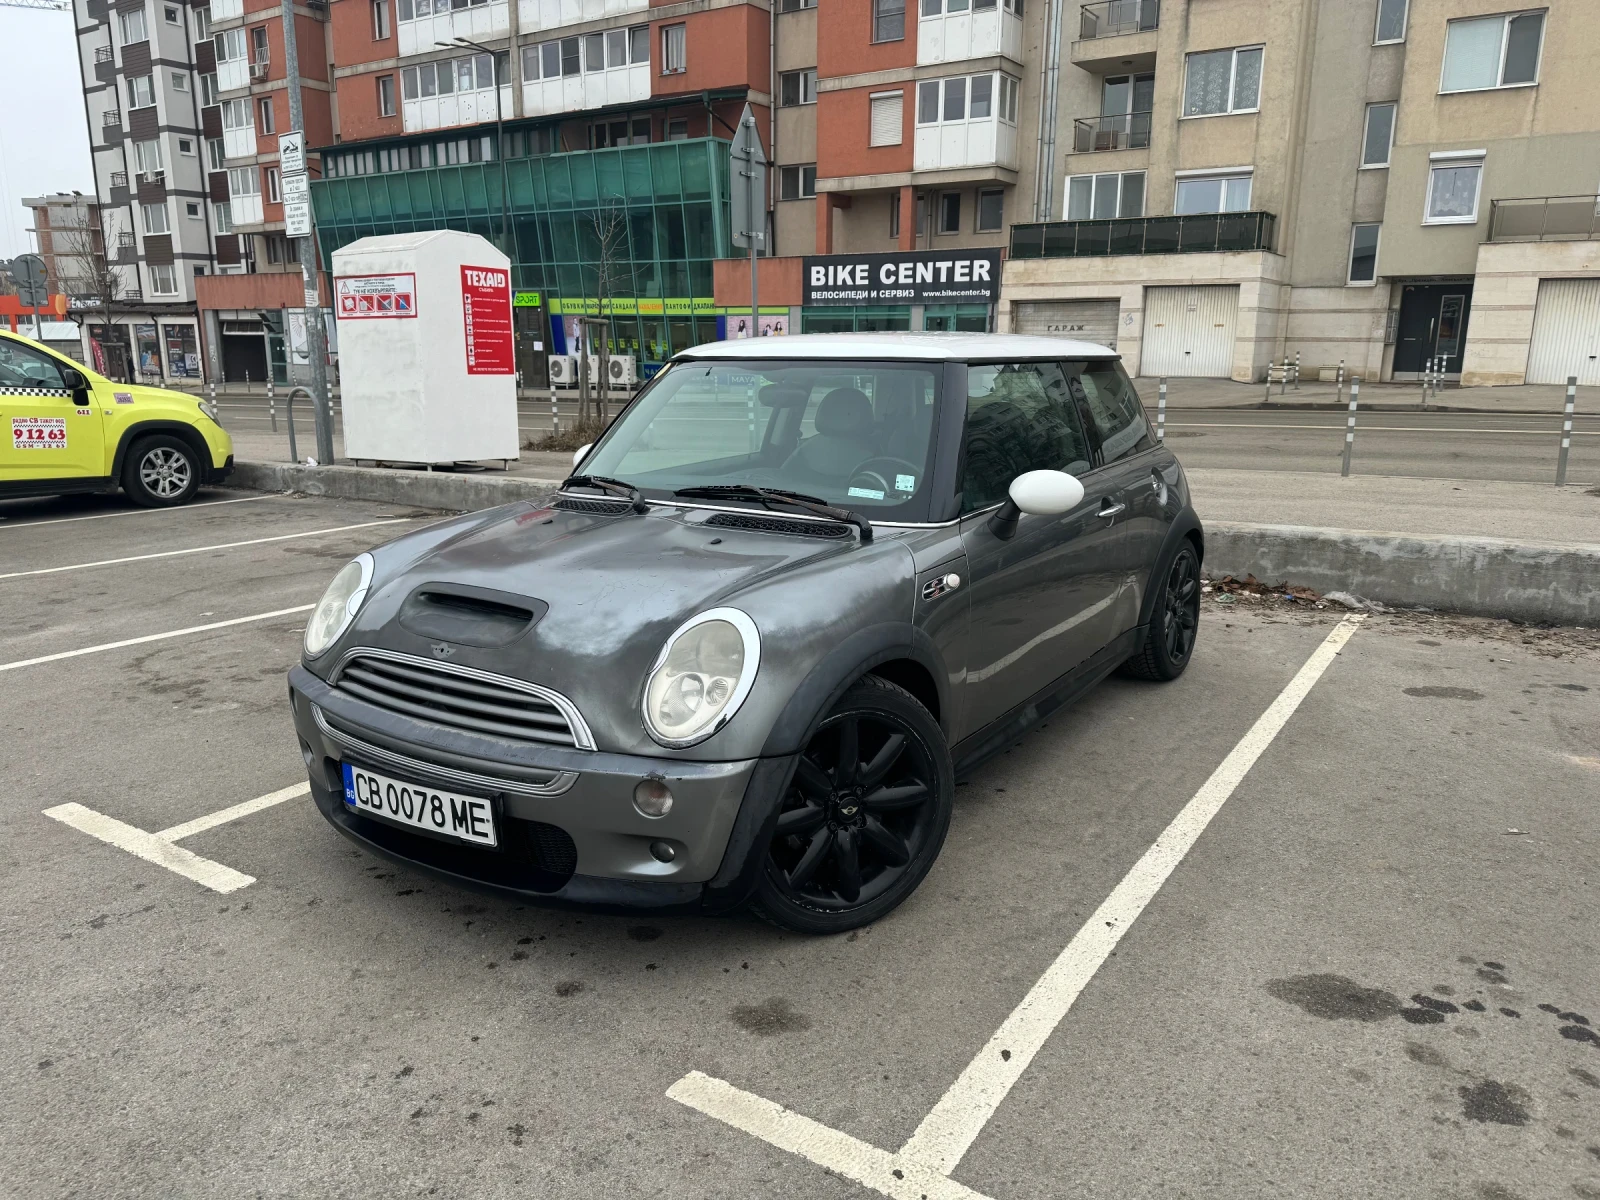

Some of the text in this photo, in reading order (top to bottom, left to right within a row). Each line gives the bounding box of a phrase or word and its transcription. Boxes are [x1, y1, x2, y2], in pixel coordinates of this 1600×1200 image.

[810, 260, 991, 286] BIKE CENTER
[464, 270, 506, 288] TEXAID
[811, 290, 869, 299] ВЕЛОСИПЕДИ
[879, 289, 914, 298] СЕРВИЗ
[922, 289, 990, 297] www.bikecenter.bg
[516, 296, 538, 304] SPORT
[14, 429, 66, 440] 9 12 63
[346, 788, 355, 799] BG
